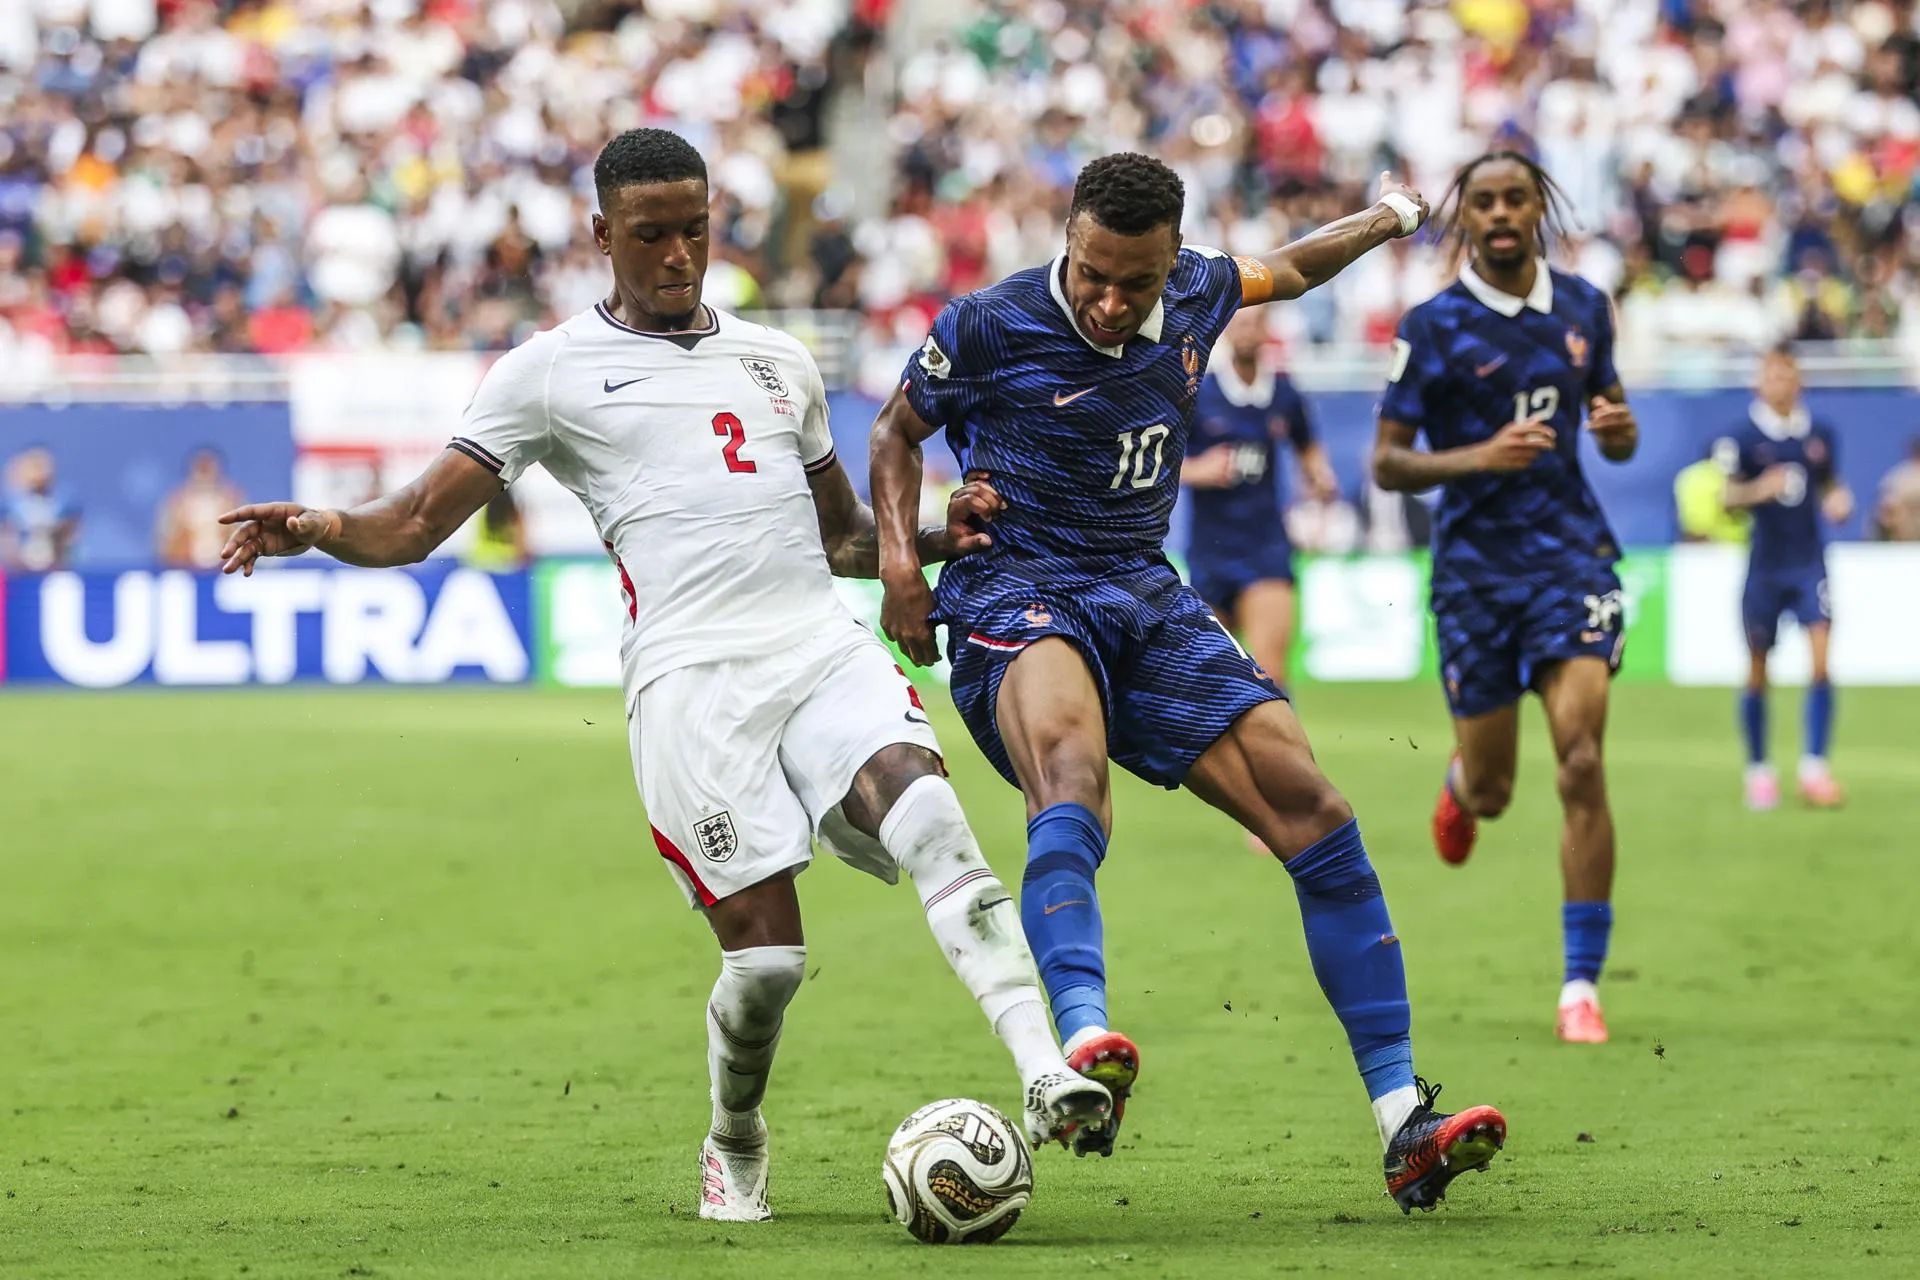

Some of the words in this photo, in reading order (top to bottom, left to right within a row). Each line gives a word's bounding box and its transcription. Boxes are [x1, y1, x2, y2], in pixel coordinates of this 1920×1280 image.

[1512, 385, 1560, 426] 12
[711, 412, 757, 473] 2
[1110, 424, 1169, 489] 10
[40, 569, 529, 688] ULTRA
